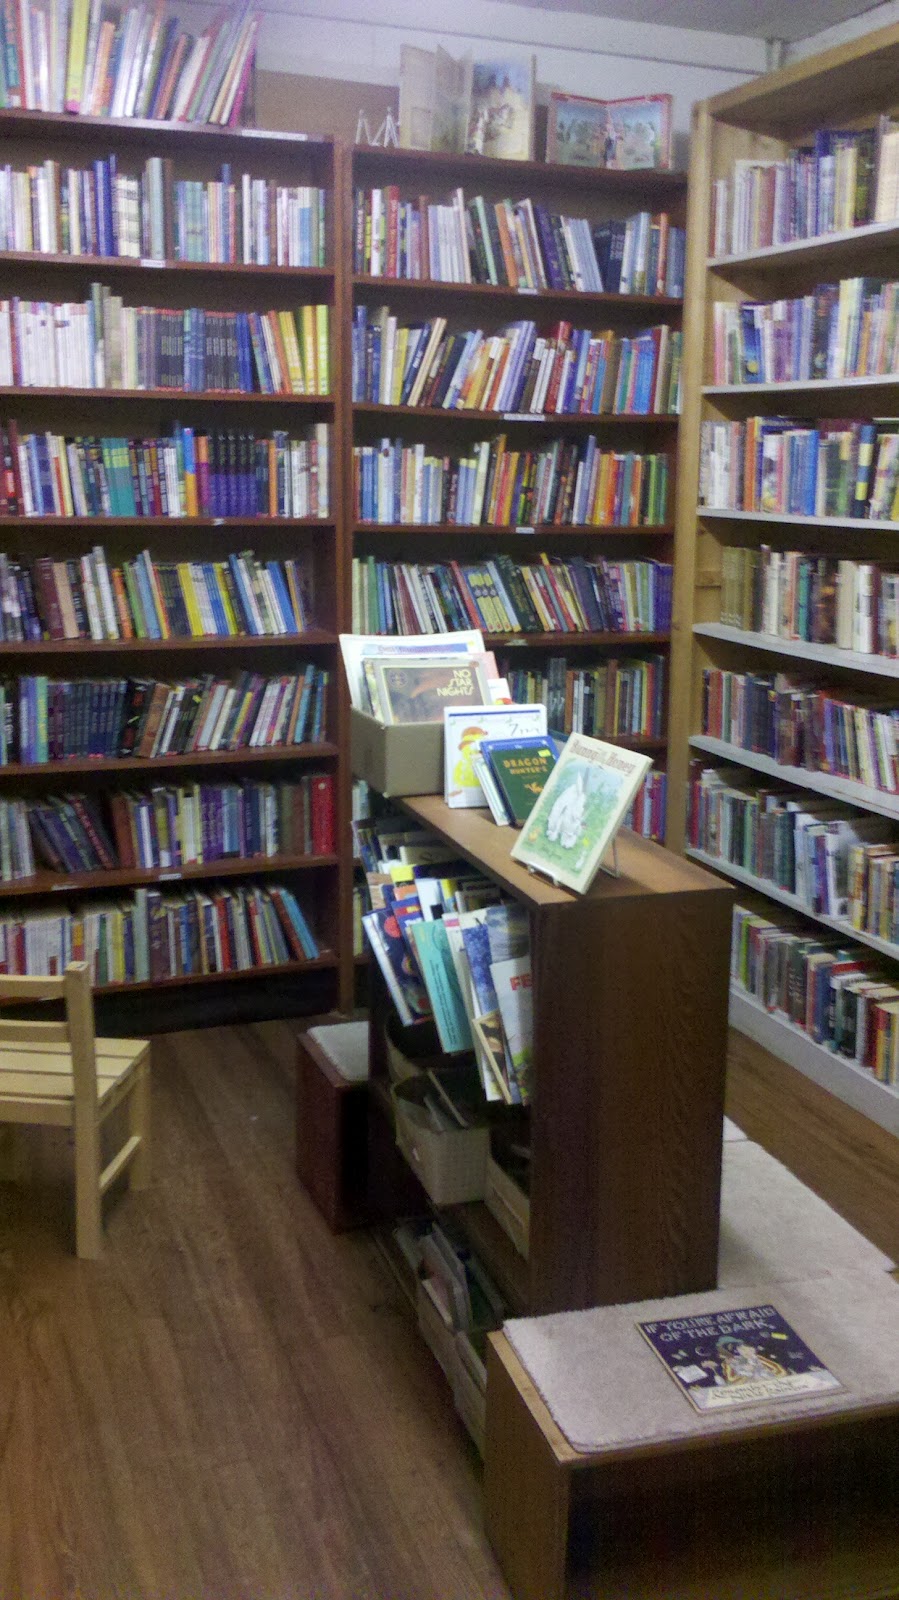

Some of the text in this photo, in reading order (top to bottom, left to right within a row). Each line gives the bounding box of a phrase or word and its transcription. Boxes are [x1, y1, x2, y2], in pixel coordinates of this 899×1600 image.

[453, 669, 471, 679] NO
[448, 678, 472, 688] STAR
[437, 687, 473, 697] NIGHTS
[503, 757, 547, 768] DRAGON
[643, 1322, 659, 1334] IF
[716, 1307, 777, 1323] AFRAID
[660, 1330, 681, 1342] OF
[683, 1325, 720, 1339] THE
